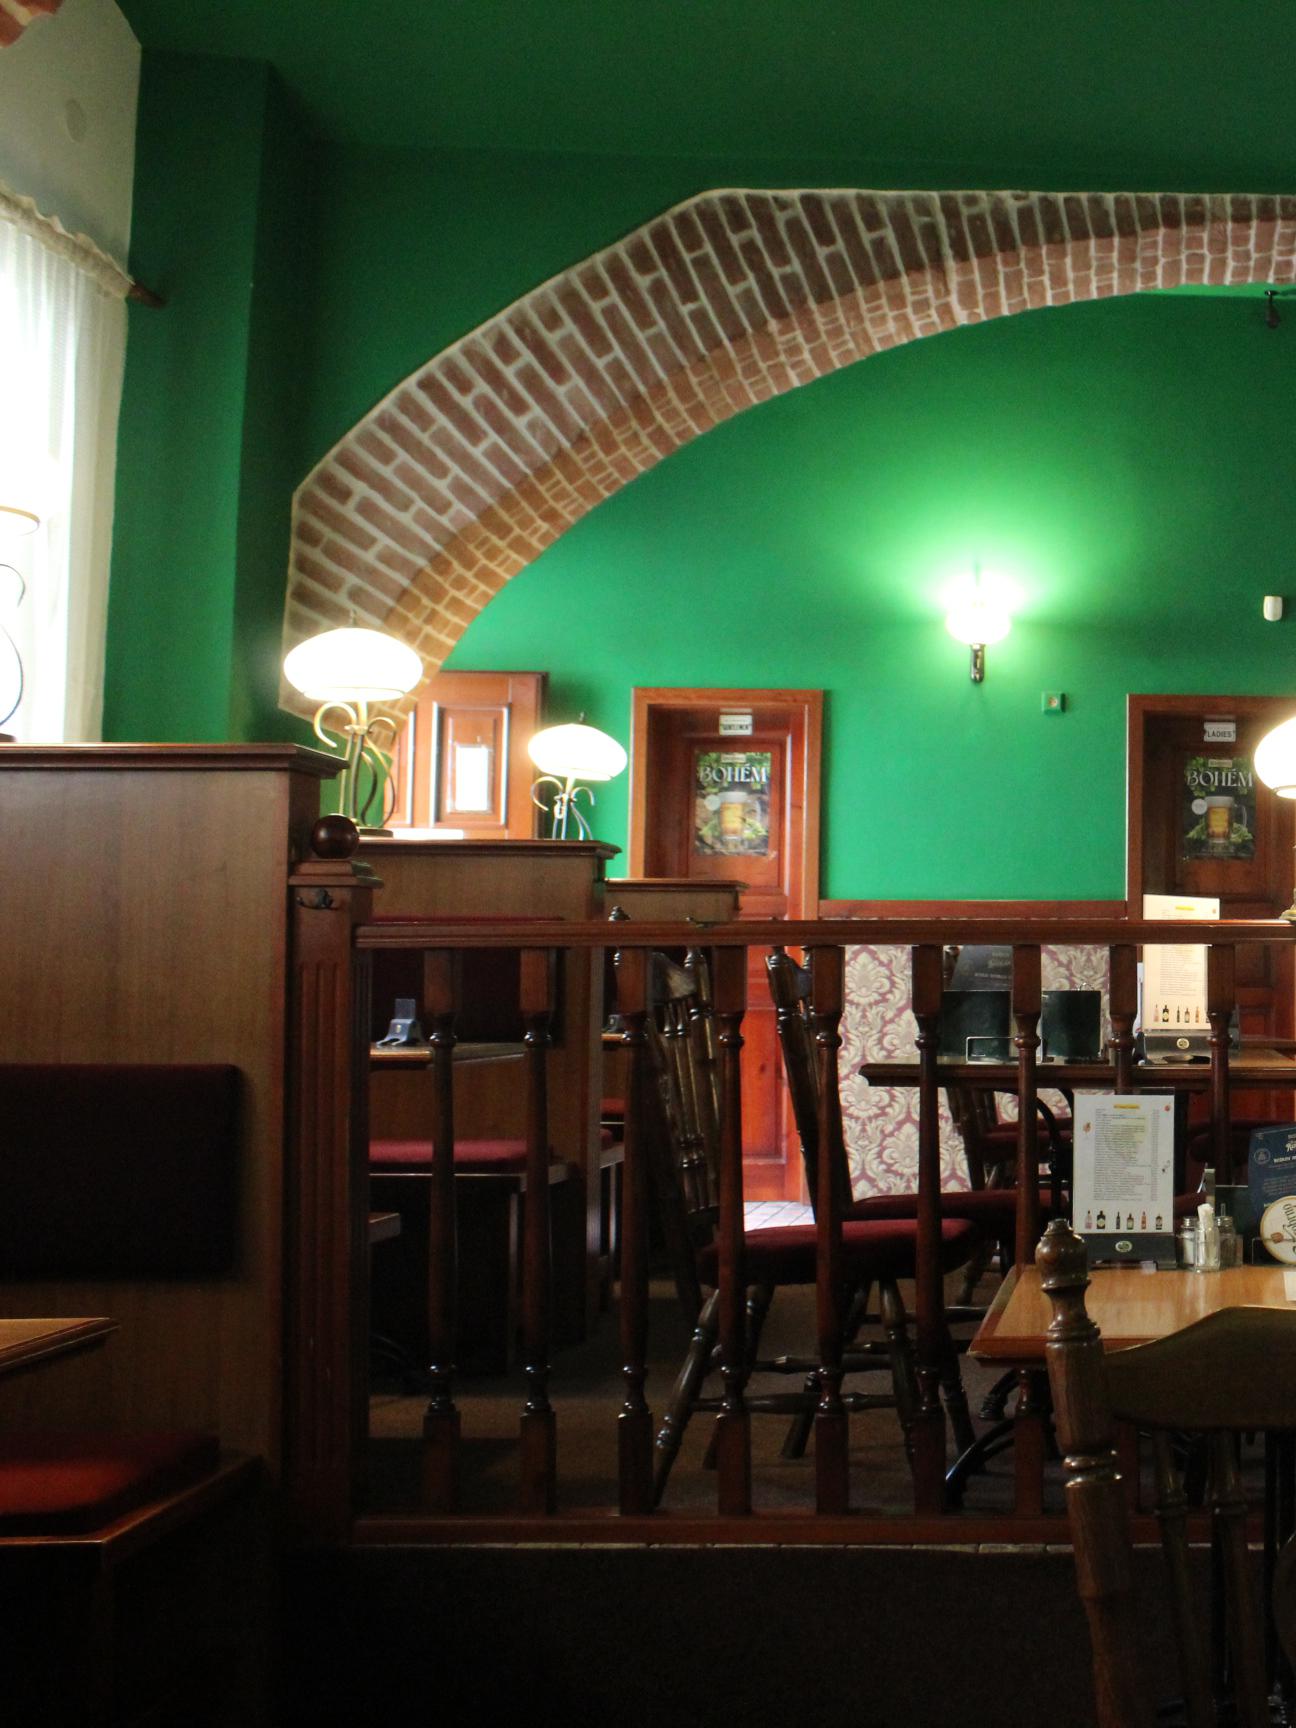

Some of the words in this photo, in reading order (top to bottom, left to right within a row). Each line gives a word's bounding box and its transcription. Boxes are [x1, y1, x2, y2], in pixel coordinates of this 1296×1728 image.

[1207, 730, 1233, 738] LADIES
[700, 763, 768, 783] BOHÉM
[1187, 768, 1253, 787] BOHÉM
